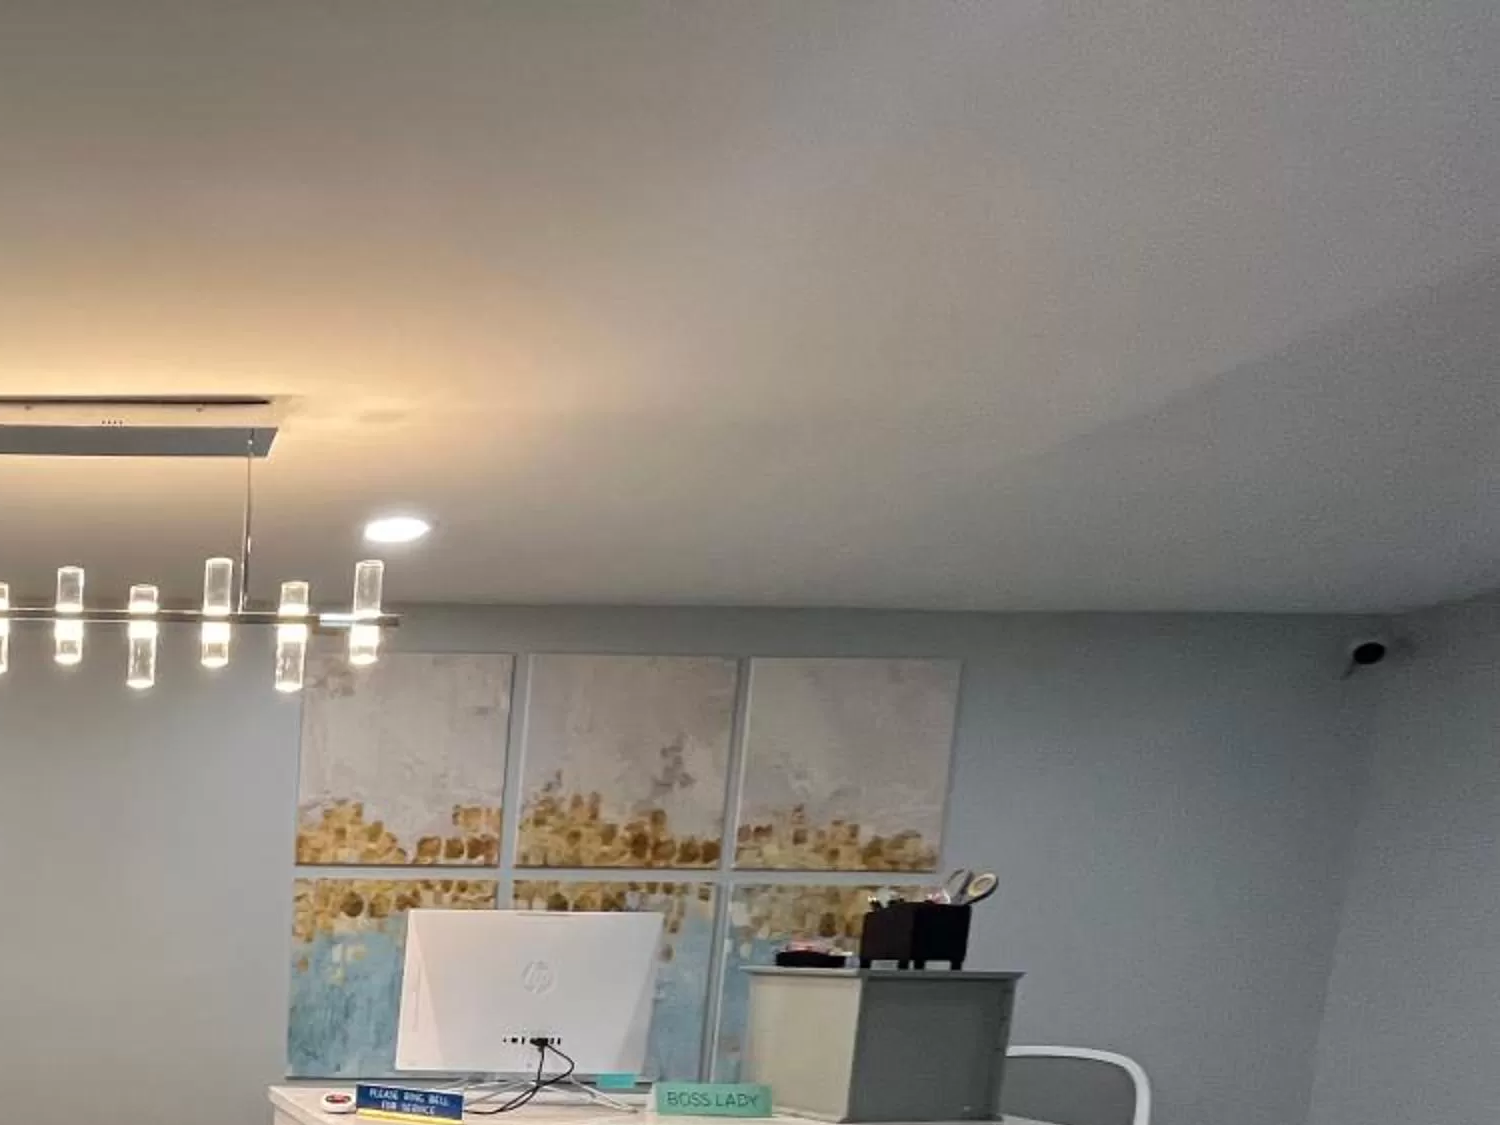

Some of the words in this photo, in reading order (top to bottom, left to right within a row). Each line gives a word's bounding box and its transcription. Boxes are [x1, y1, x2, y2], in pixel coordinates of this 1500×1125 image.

[368, 1087, 399, 1101] PLEASE
[403, 1091, 426, 1103] RING
[428, 1094, 450, 1107] BELL
[667, 1091, 711, 1107] BOSS
[715, 1092, 759, 1108] LADY
[380, 1099, 398, 1110] FOR
[401, 1103, 436, 1115] SERVICE
